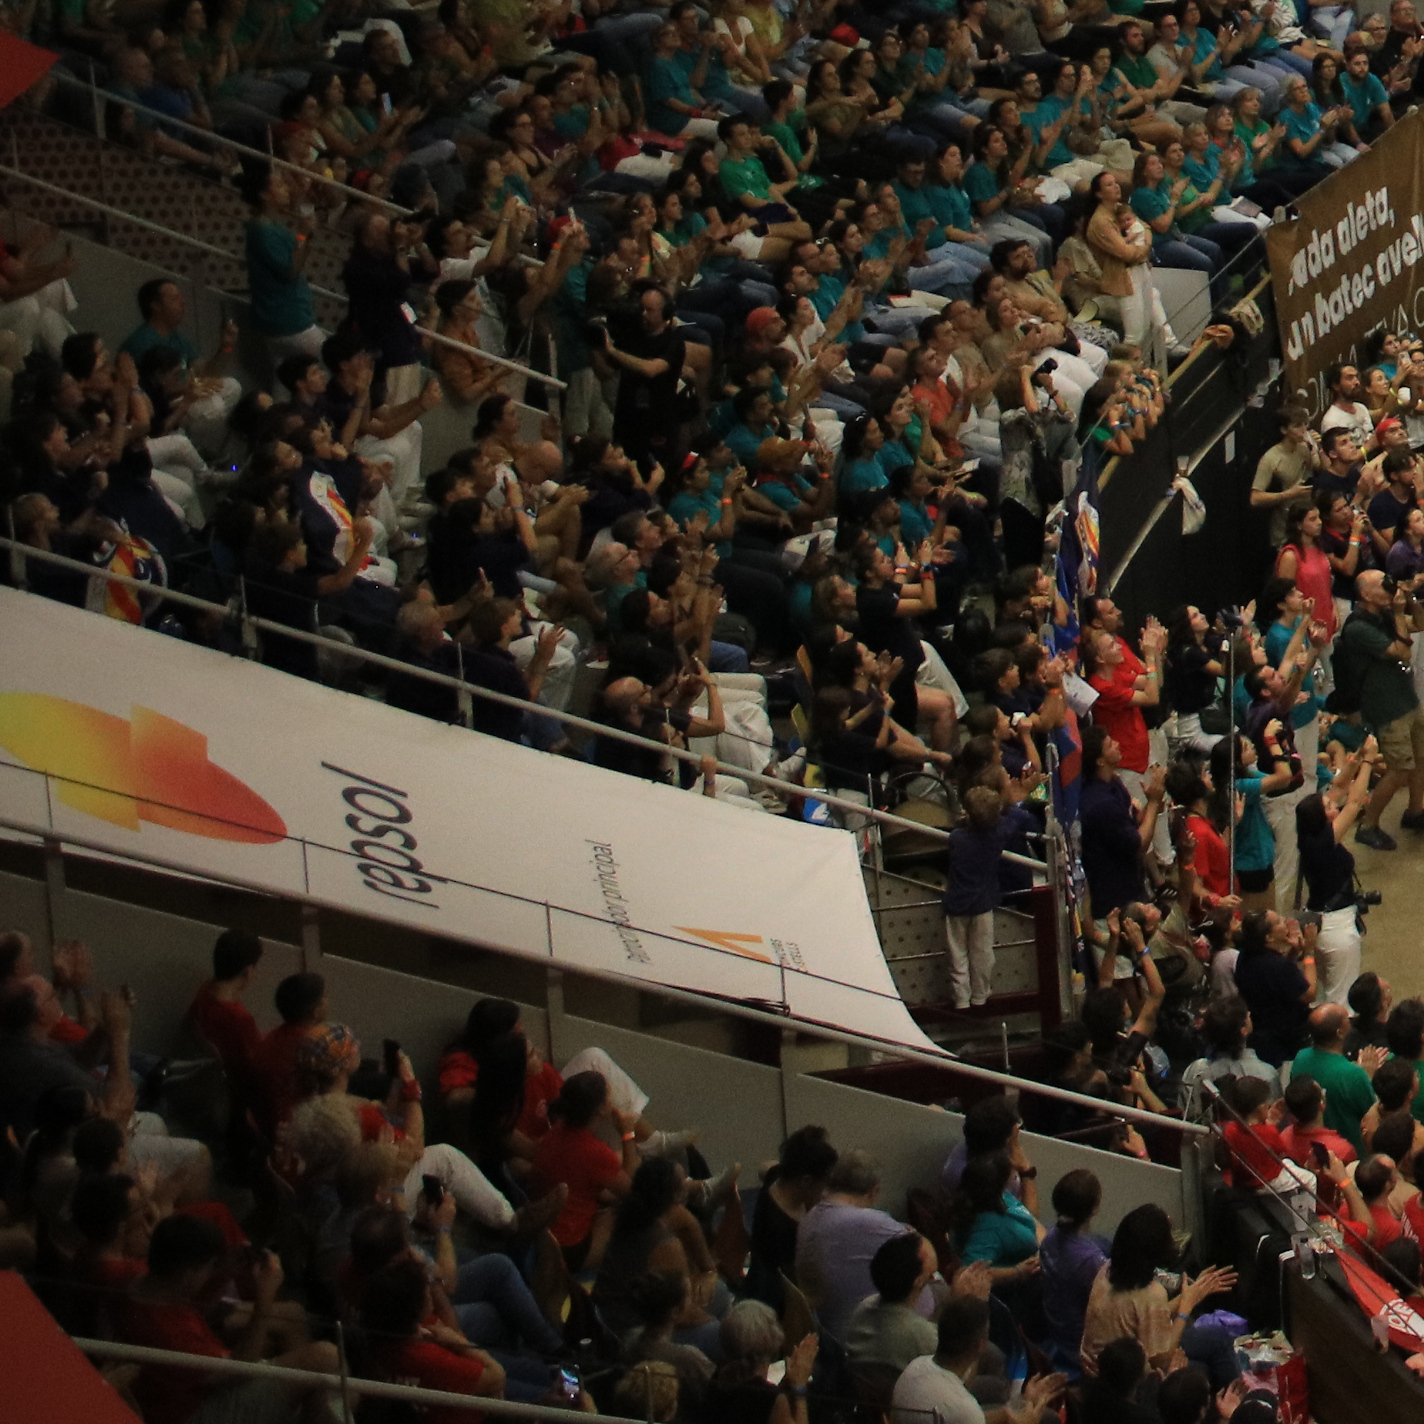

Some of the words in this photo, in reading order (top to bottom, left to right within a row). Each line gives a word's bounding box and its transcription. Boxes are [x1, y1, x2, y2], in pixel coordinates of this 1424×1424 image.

[1315, 263, 1375, 338] batec
[321, 761, 448, 909] repsol
[586, 839, 631, 903] principal
